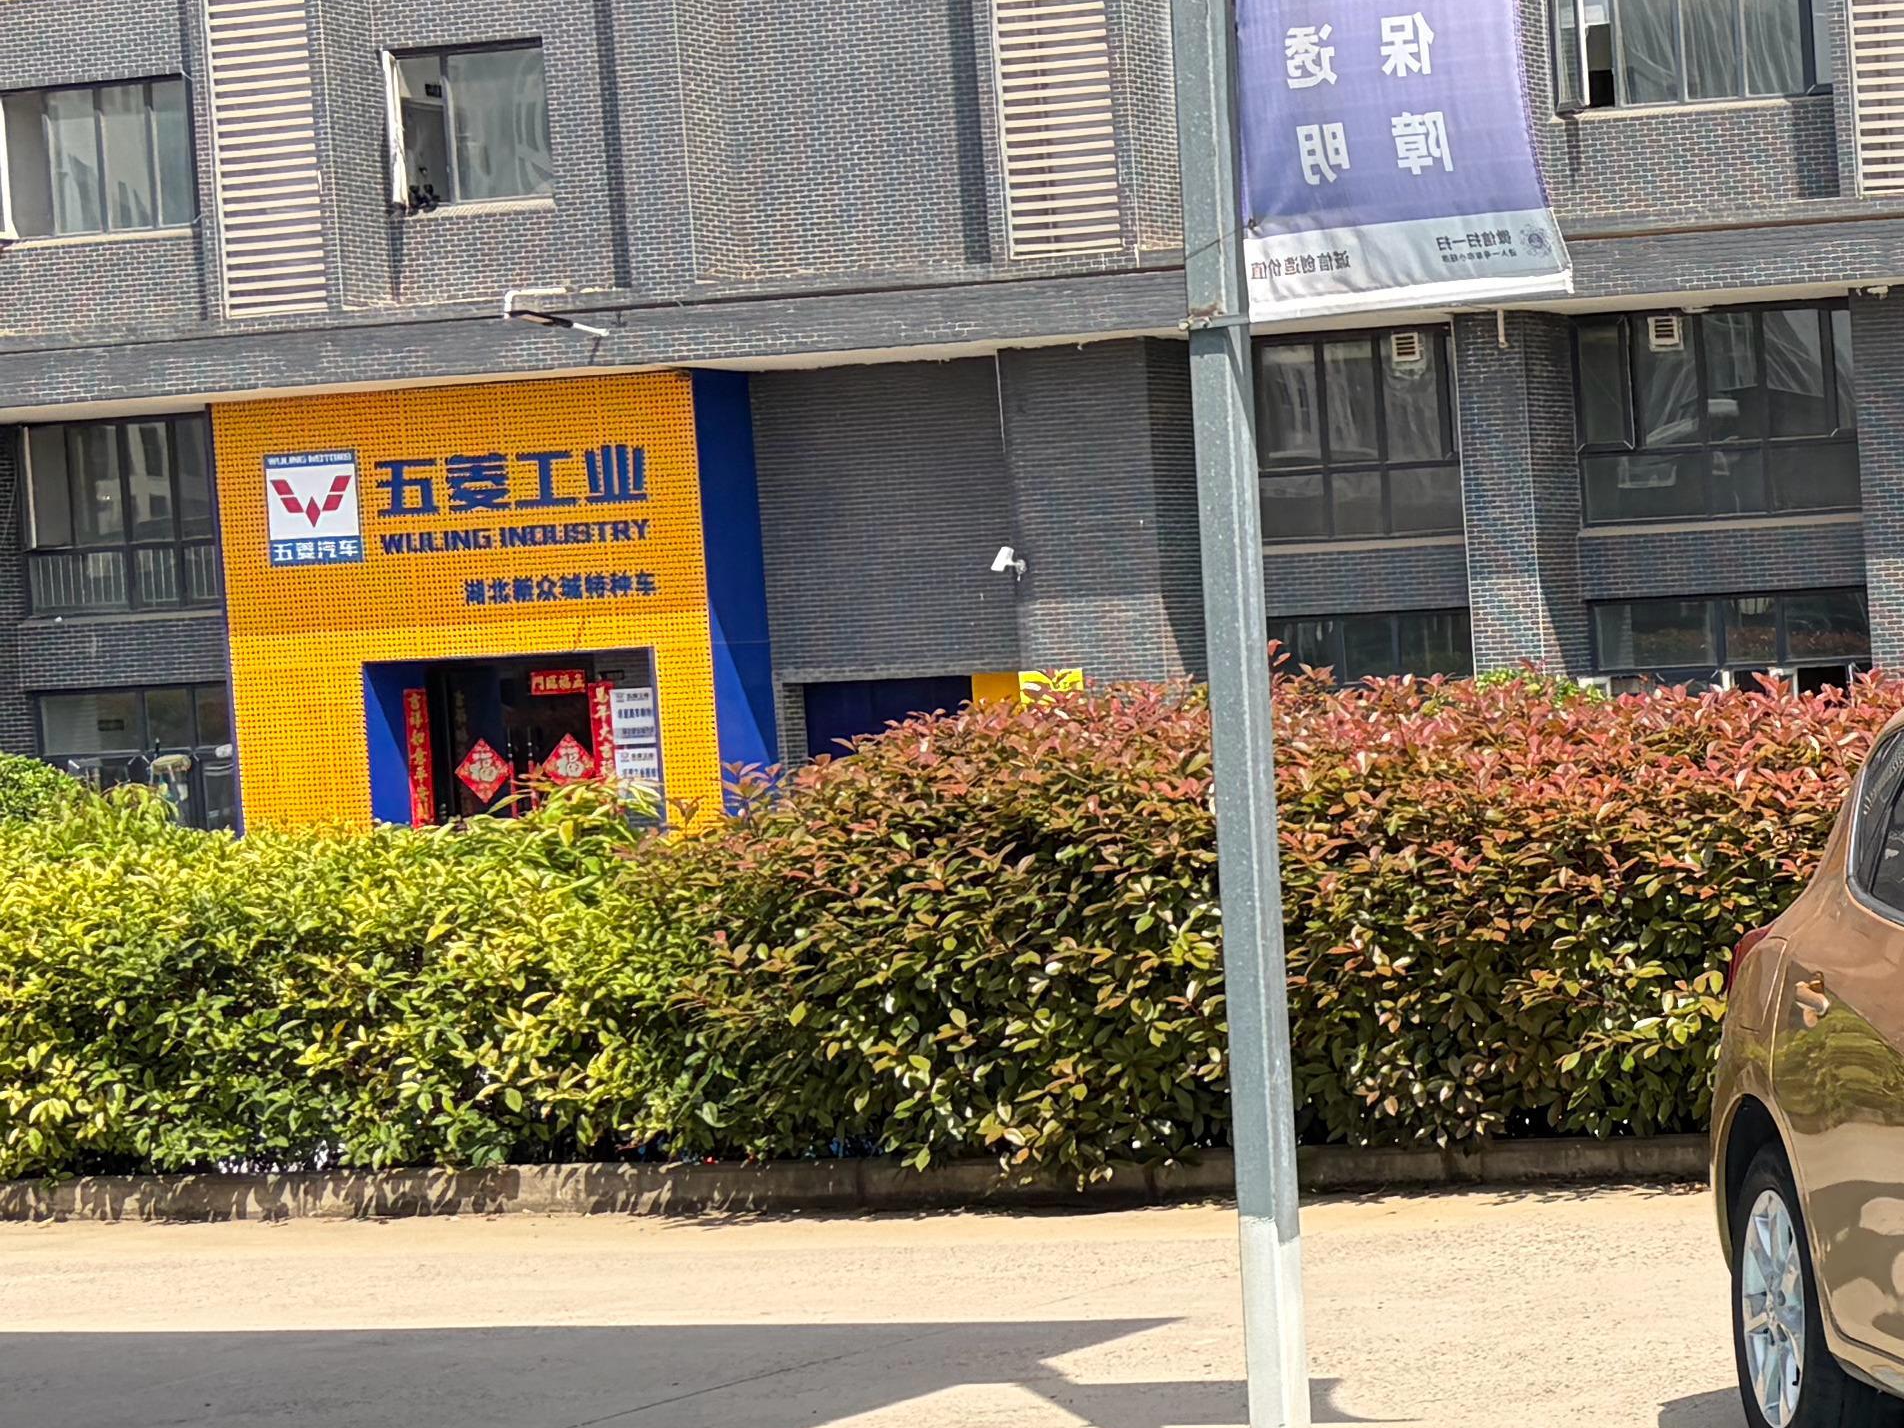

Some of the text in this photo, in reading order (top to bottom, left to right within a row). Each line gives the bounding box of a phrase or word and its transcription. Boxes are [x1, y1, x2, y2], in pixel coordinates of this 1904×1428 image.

[374, 445, 649, 516] 五菱工业
[272, 540, 359, 561] 五菱汽车
[380, 519, 650, 554] WULING INDUSTRY
